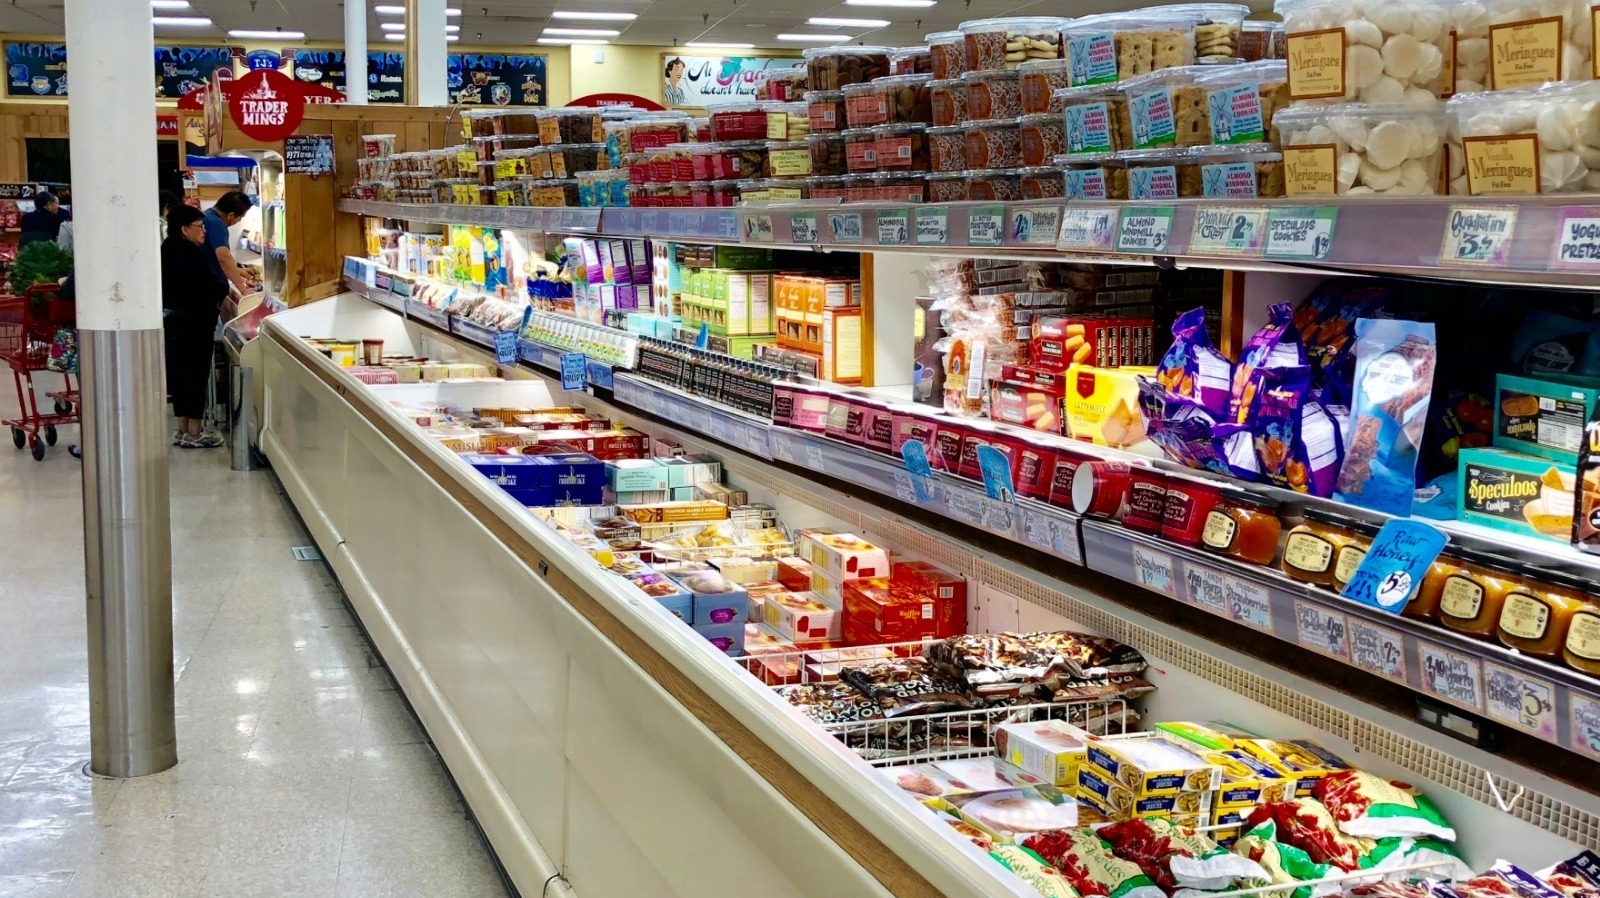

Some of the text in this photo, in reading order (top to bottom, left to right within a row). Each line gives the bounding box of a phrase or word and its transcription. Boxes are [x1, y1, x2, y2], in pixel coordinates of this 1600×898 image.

[1497, 43, 1556, 64] Meringues
[1291, 48, 1340, 72] Meringues
[688, 61, 712, 81] At
[700, 79, 756, 95] doesn't have
[1148, 97, 1168, 107] ALMOND
[1231, 92, 1256, 103] ALMOND
[240, 101, 289, 113] TRADER
[1233, 108, 1258, 117] COOKIES
[243, 113, 286, 125] MINGS
[1149, 112, 1170, 122] COOKIES
[1286, 162, 1333, 184] Meringues
[1473, 158, 1533, 180] Meringues
[1226, 187, 1253, 195] COOKIES
[1126, 217, 1156, 227] ALMOND
[1271, 219, 1316, 231] SPECULOOS
[1121, 228, 1154, 237] WINDMILL
[1273, 231, 1307, 242] COOKIES
[1122, 237, 1147, 246] COOKIES
[482, 440, 539, 450] TIRAMISU
[1468, 473, 1538, 505] Speculoos
[1485, 499, 1511, 512] Cookies
[1391, 530, 1429, 546] Raw
[1368, 544, 1424, 571] Honey
[1226, 583, 1270, 613] Strawberries
[1576, 856, 1600, 880] BE
